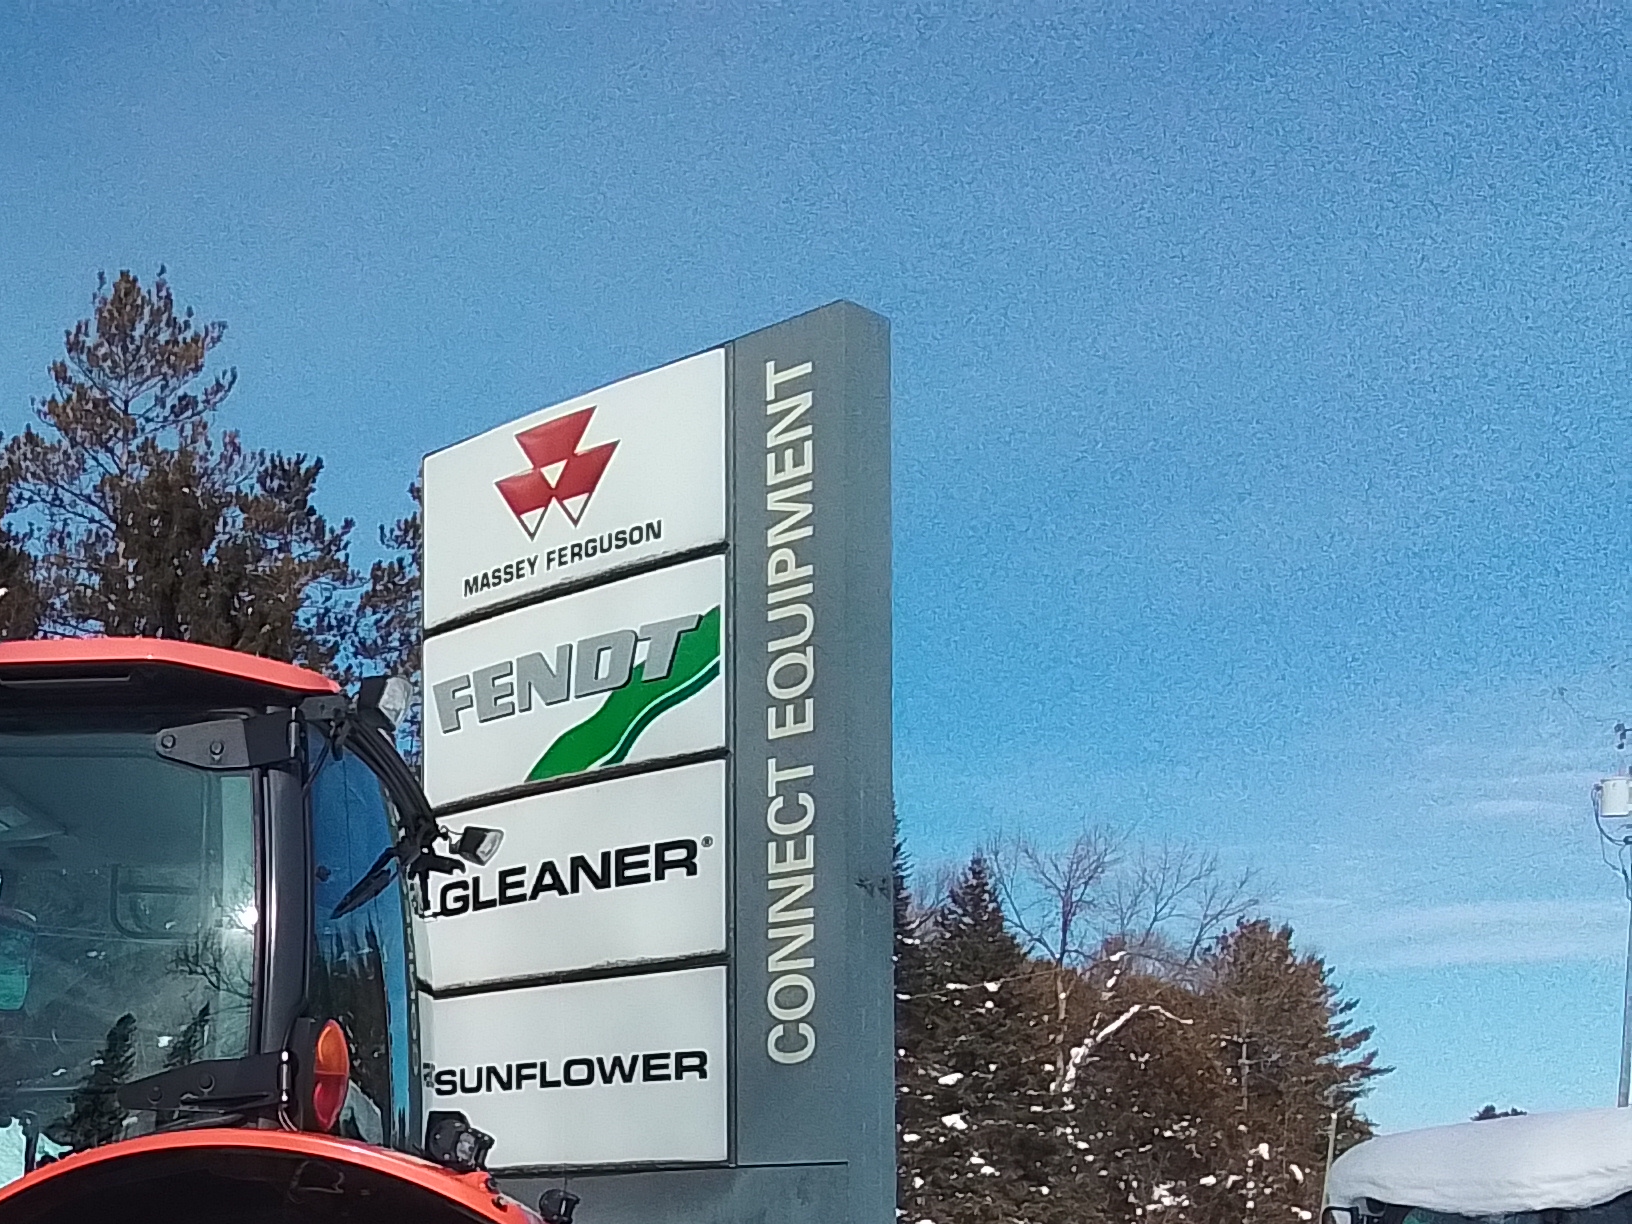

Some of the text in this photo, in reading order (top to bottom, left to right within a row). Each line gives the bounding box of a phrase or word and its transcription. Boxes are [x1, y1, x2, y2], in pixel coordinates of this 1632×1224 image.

[463, 520, 663, 597] MASSEY FERGUSON
[432, 613, 704, 734] FENDT
[766, 360, 817, 1066] CONNECT EQUIPMENT
[433, 1051, 709, 1097] SUNFLOWER
